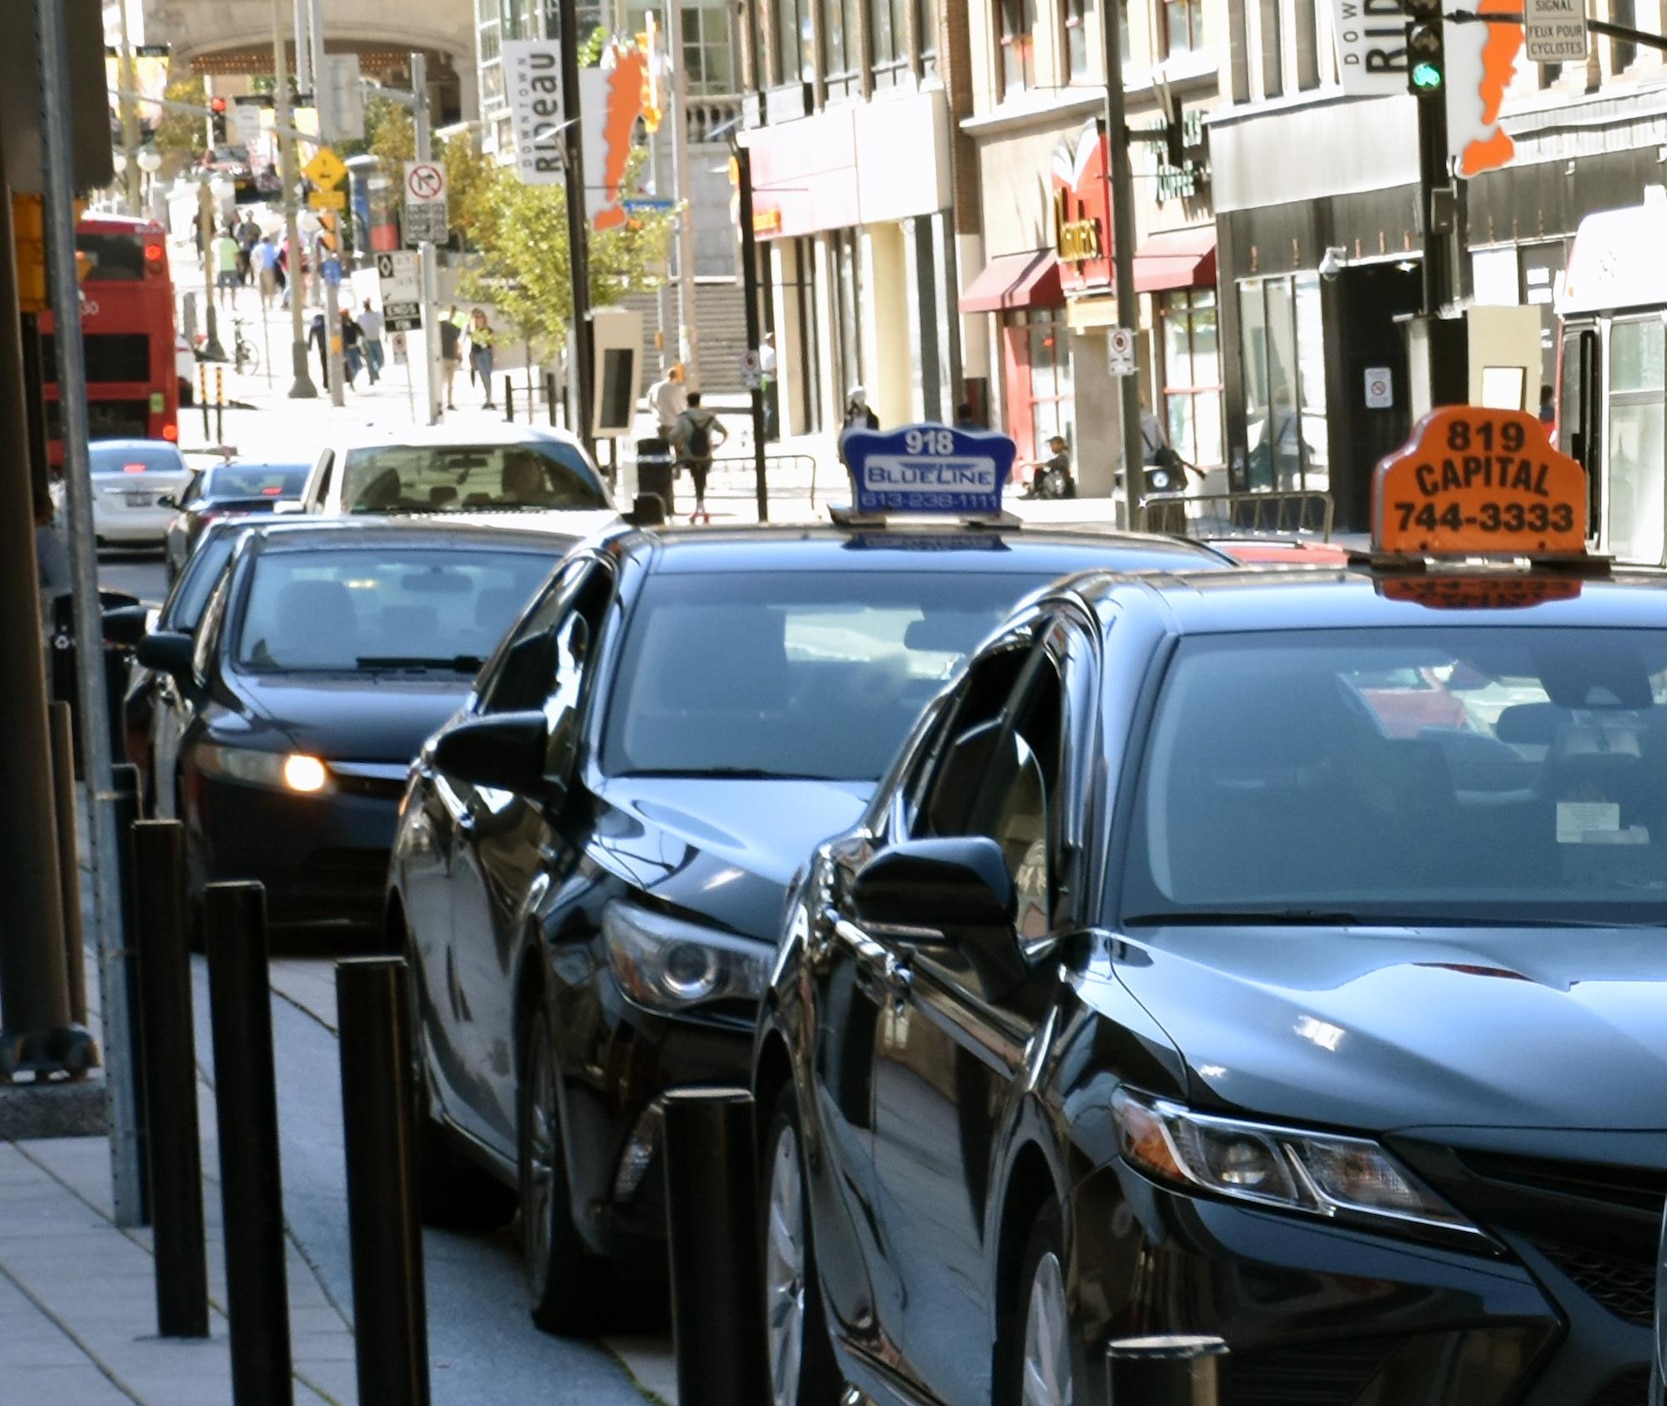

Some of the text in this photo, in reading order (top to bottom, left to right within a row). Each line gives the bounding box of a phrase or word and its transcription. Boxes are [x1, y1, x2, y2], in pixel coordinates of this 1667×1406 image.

[1535, 0, 1574, 12] SIGNAL
[1529, 25, 1583, 38] FEUX POUR
[1531, 42, 1583, 55] CYCLISTES
[517, 57, 533, 169] DOWNTOWN
[905, 430, 954, 455] 918
[1447, 420, 1526, 454] 819
[1416, 456, 1549, 497] CAPITAL
[862, 492, 997, 508] 613-238-1111
[1394, 502, 1574, 532] 744-3333
